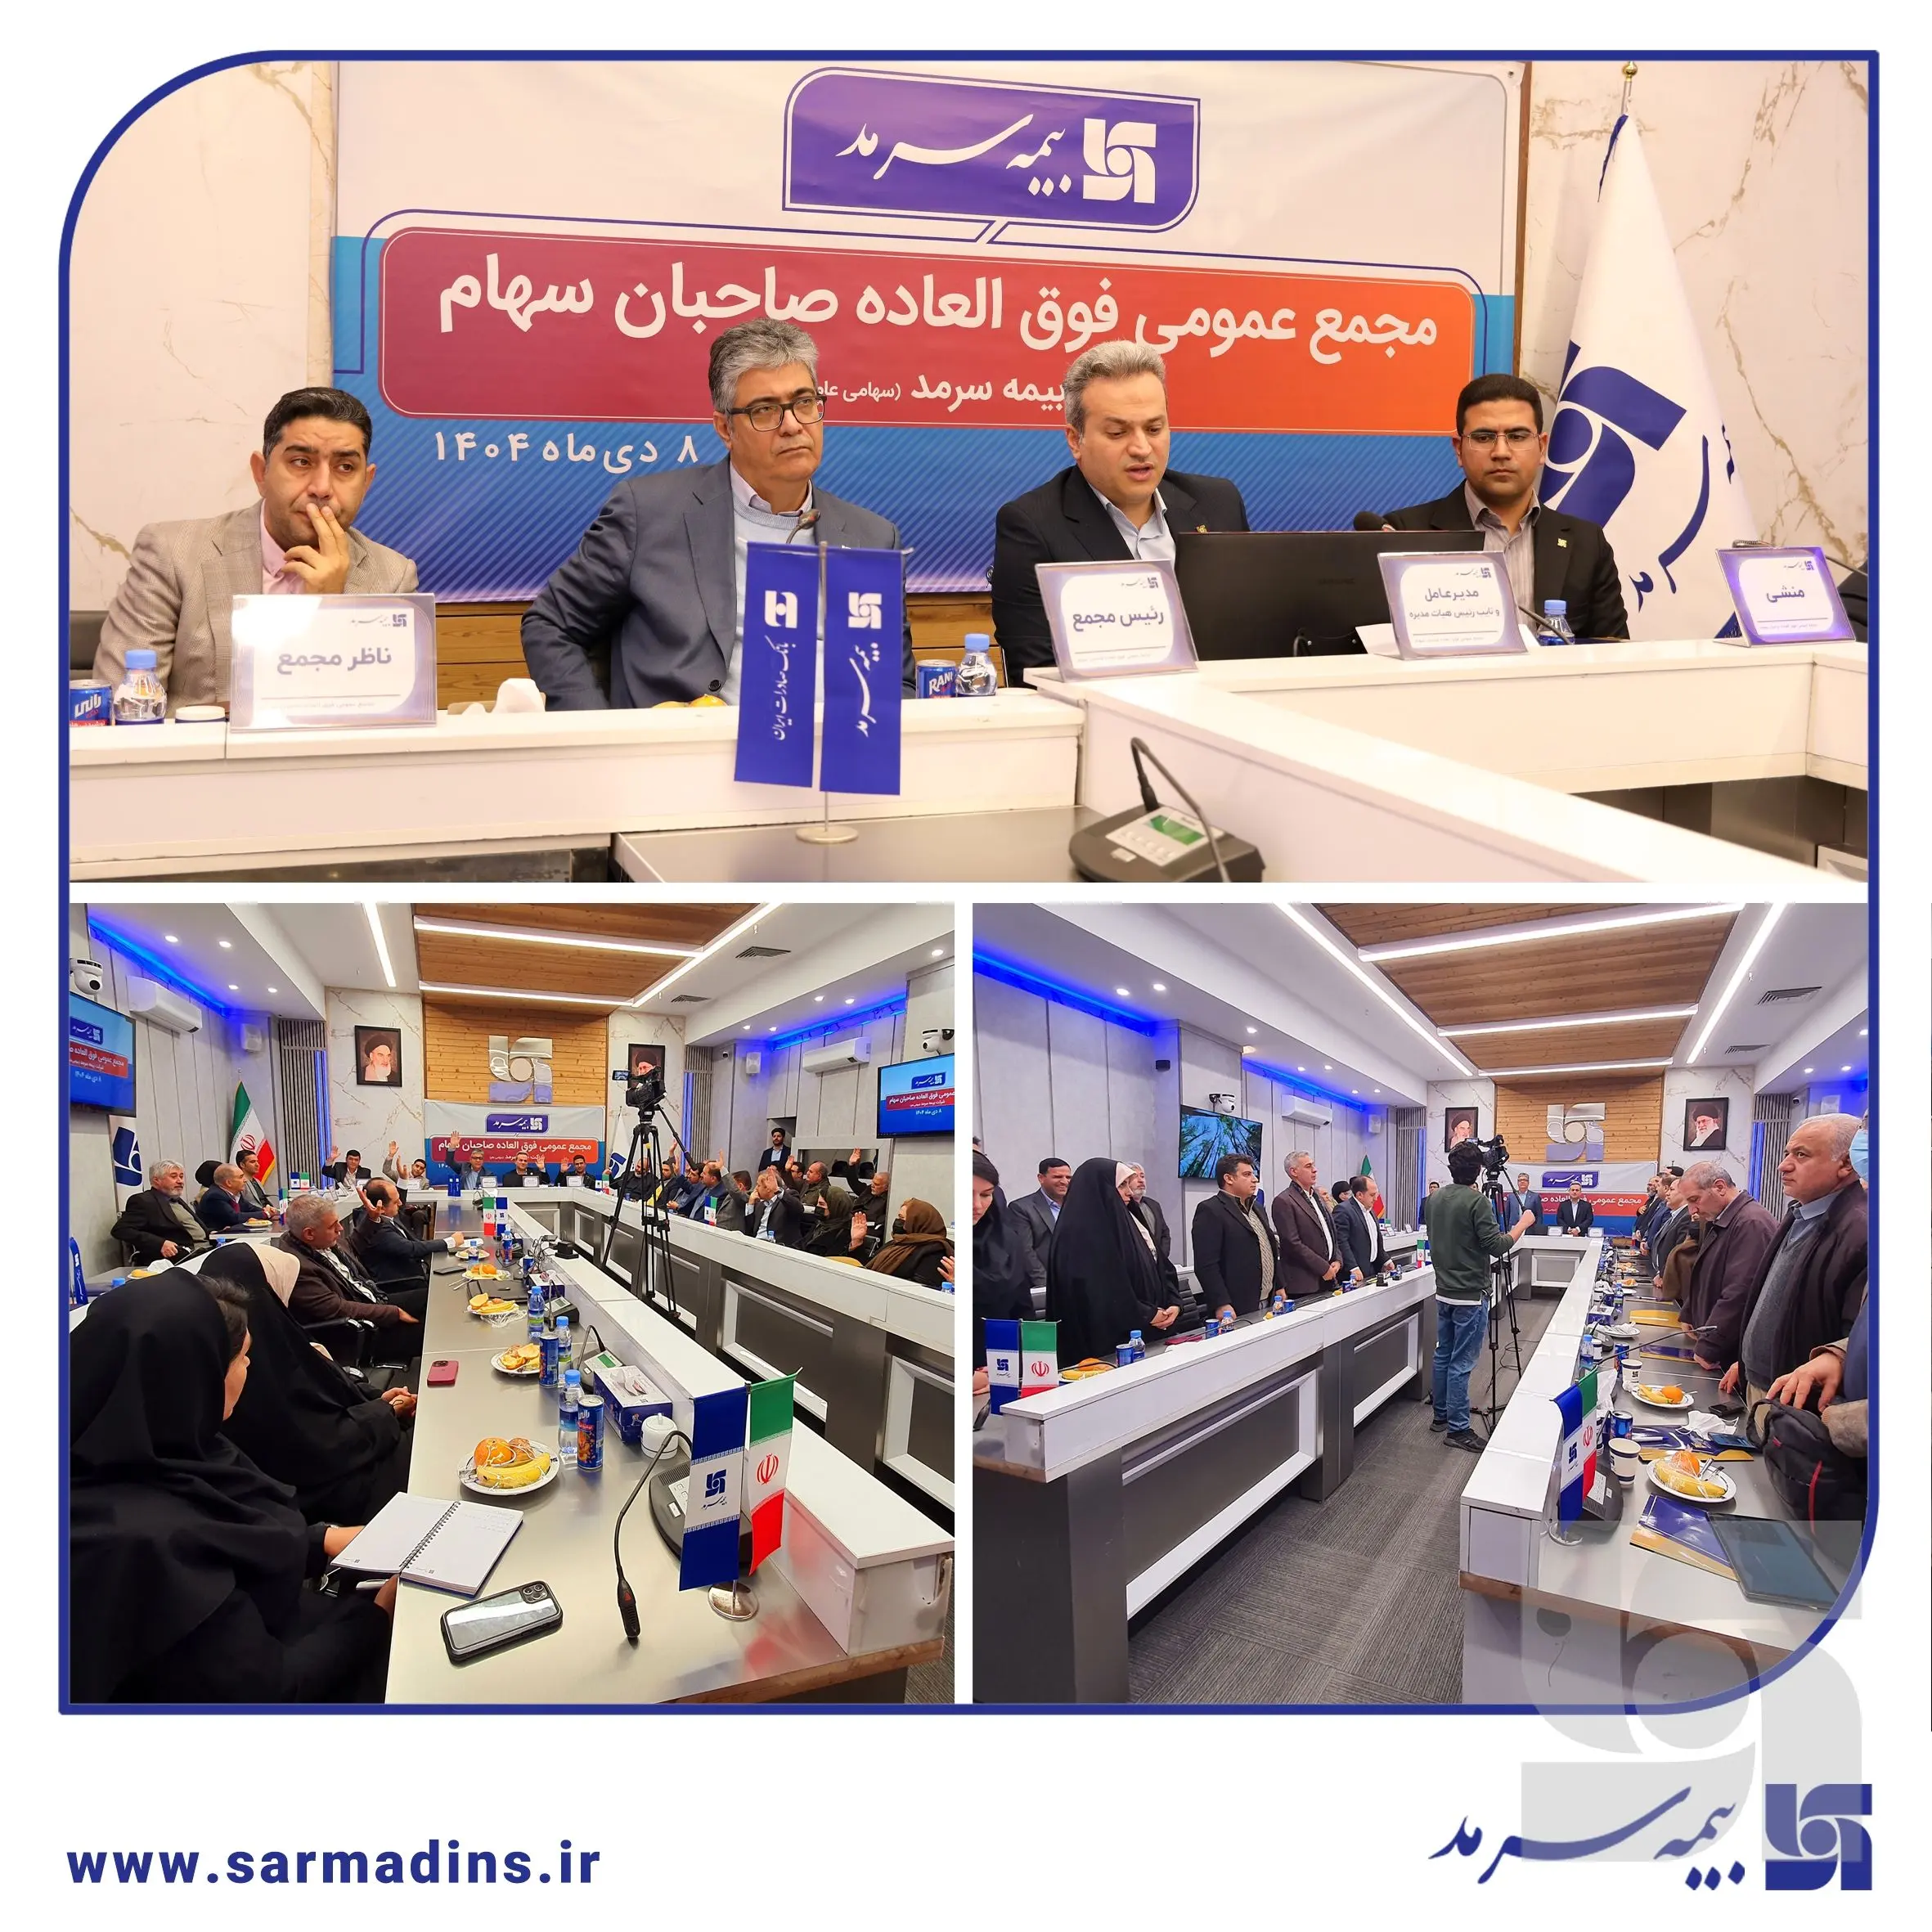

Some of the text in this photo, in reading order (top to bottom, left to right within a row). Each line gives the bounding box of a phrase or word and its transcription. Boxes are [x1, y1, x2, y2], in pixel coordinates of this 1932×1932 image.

[836, 113, 1072, 196] بیمه سرمد
[439, 254, 1437, 363] مجمع عمومی فوق العاده صاحبان سهام
[910, 374, 994, 413] سرمد
[1002, 377, 1065, 411] بیمه
[435, 431, 530, 462] ۱۴۰۴
[677, 435, 699, 463] ۸
[1766, 585, 1805, 603] منشی
[1072, 606, 1164, 632] رئیس مجمع
[276, 647, 393, 675] ناظر مجمع
[929, 671, 953, 695] RANI
[496, 1140, 519, 1149] العاده
[521, 1140, 537, 1152] فوق
[539, 1143, 567, 1152] عمومی
[568, 1143, 591, 1152] مجمع
[1617, 1197, 1642, 1206] مجمع
